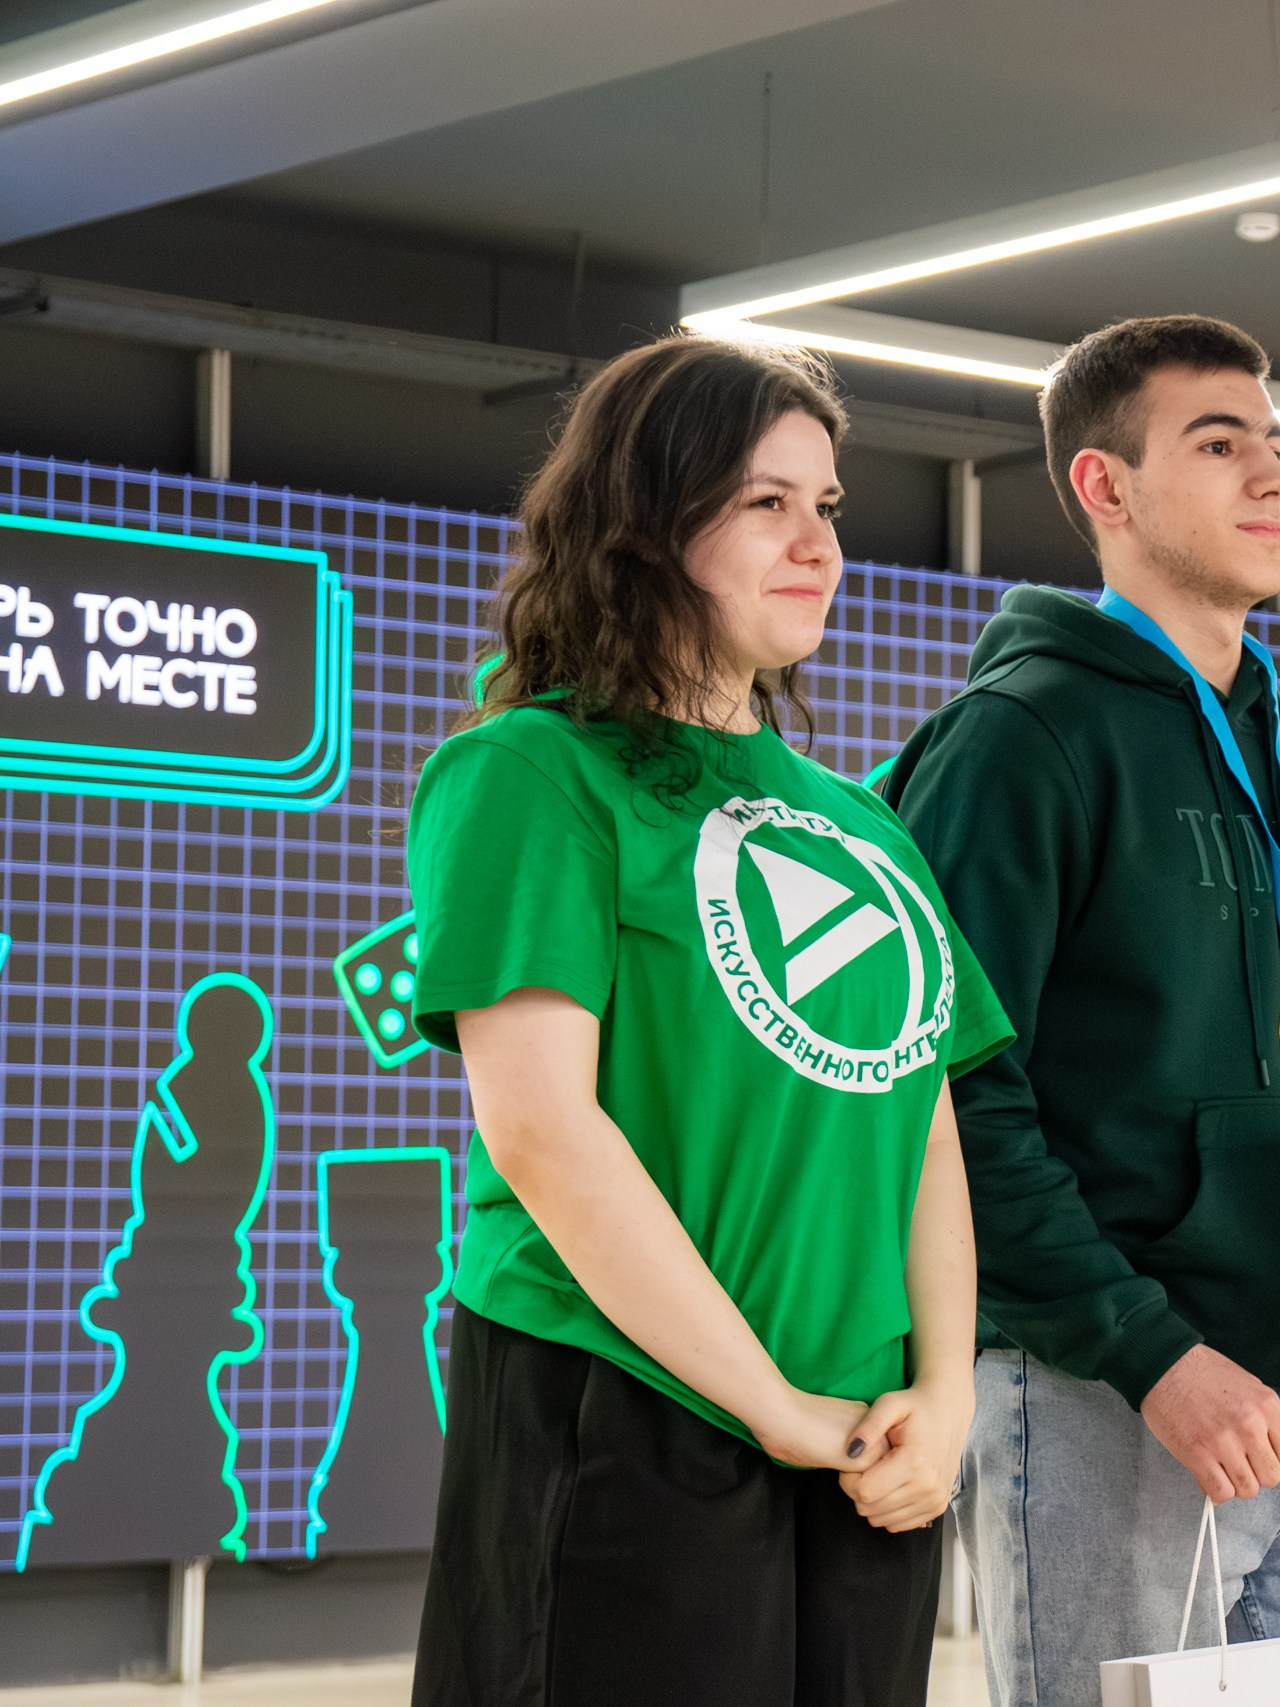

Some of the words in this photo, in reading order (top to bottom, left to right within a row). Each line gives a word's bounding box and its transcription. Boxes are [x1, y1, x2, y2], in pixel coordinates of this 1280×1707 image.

[73, 592, 257, 658] ТОЧНО
[86, 650, 257, 715] МЕСТЕ
[707, 898, 889, 1083] ИСКУССТВЕННОГО
